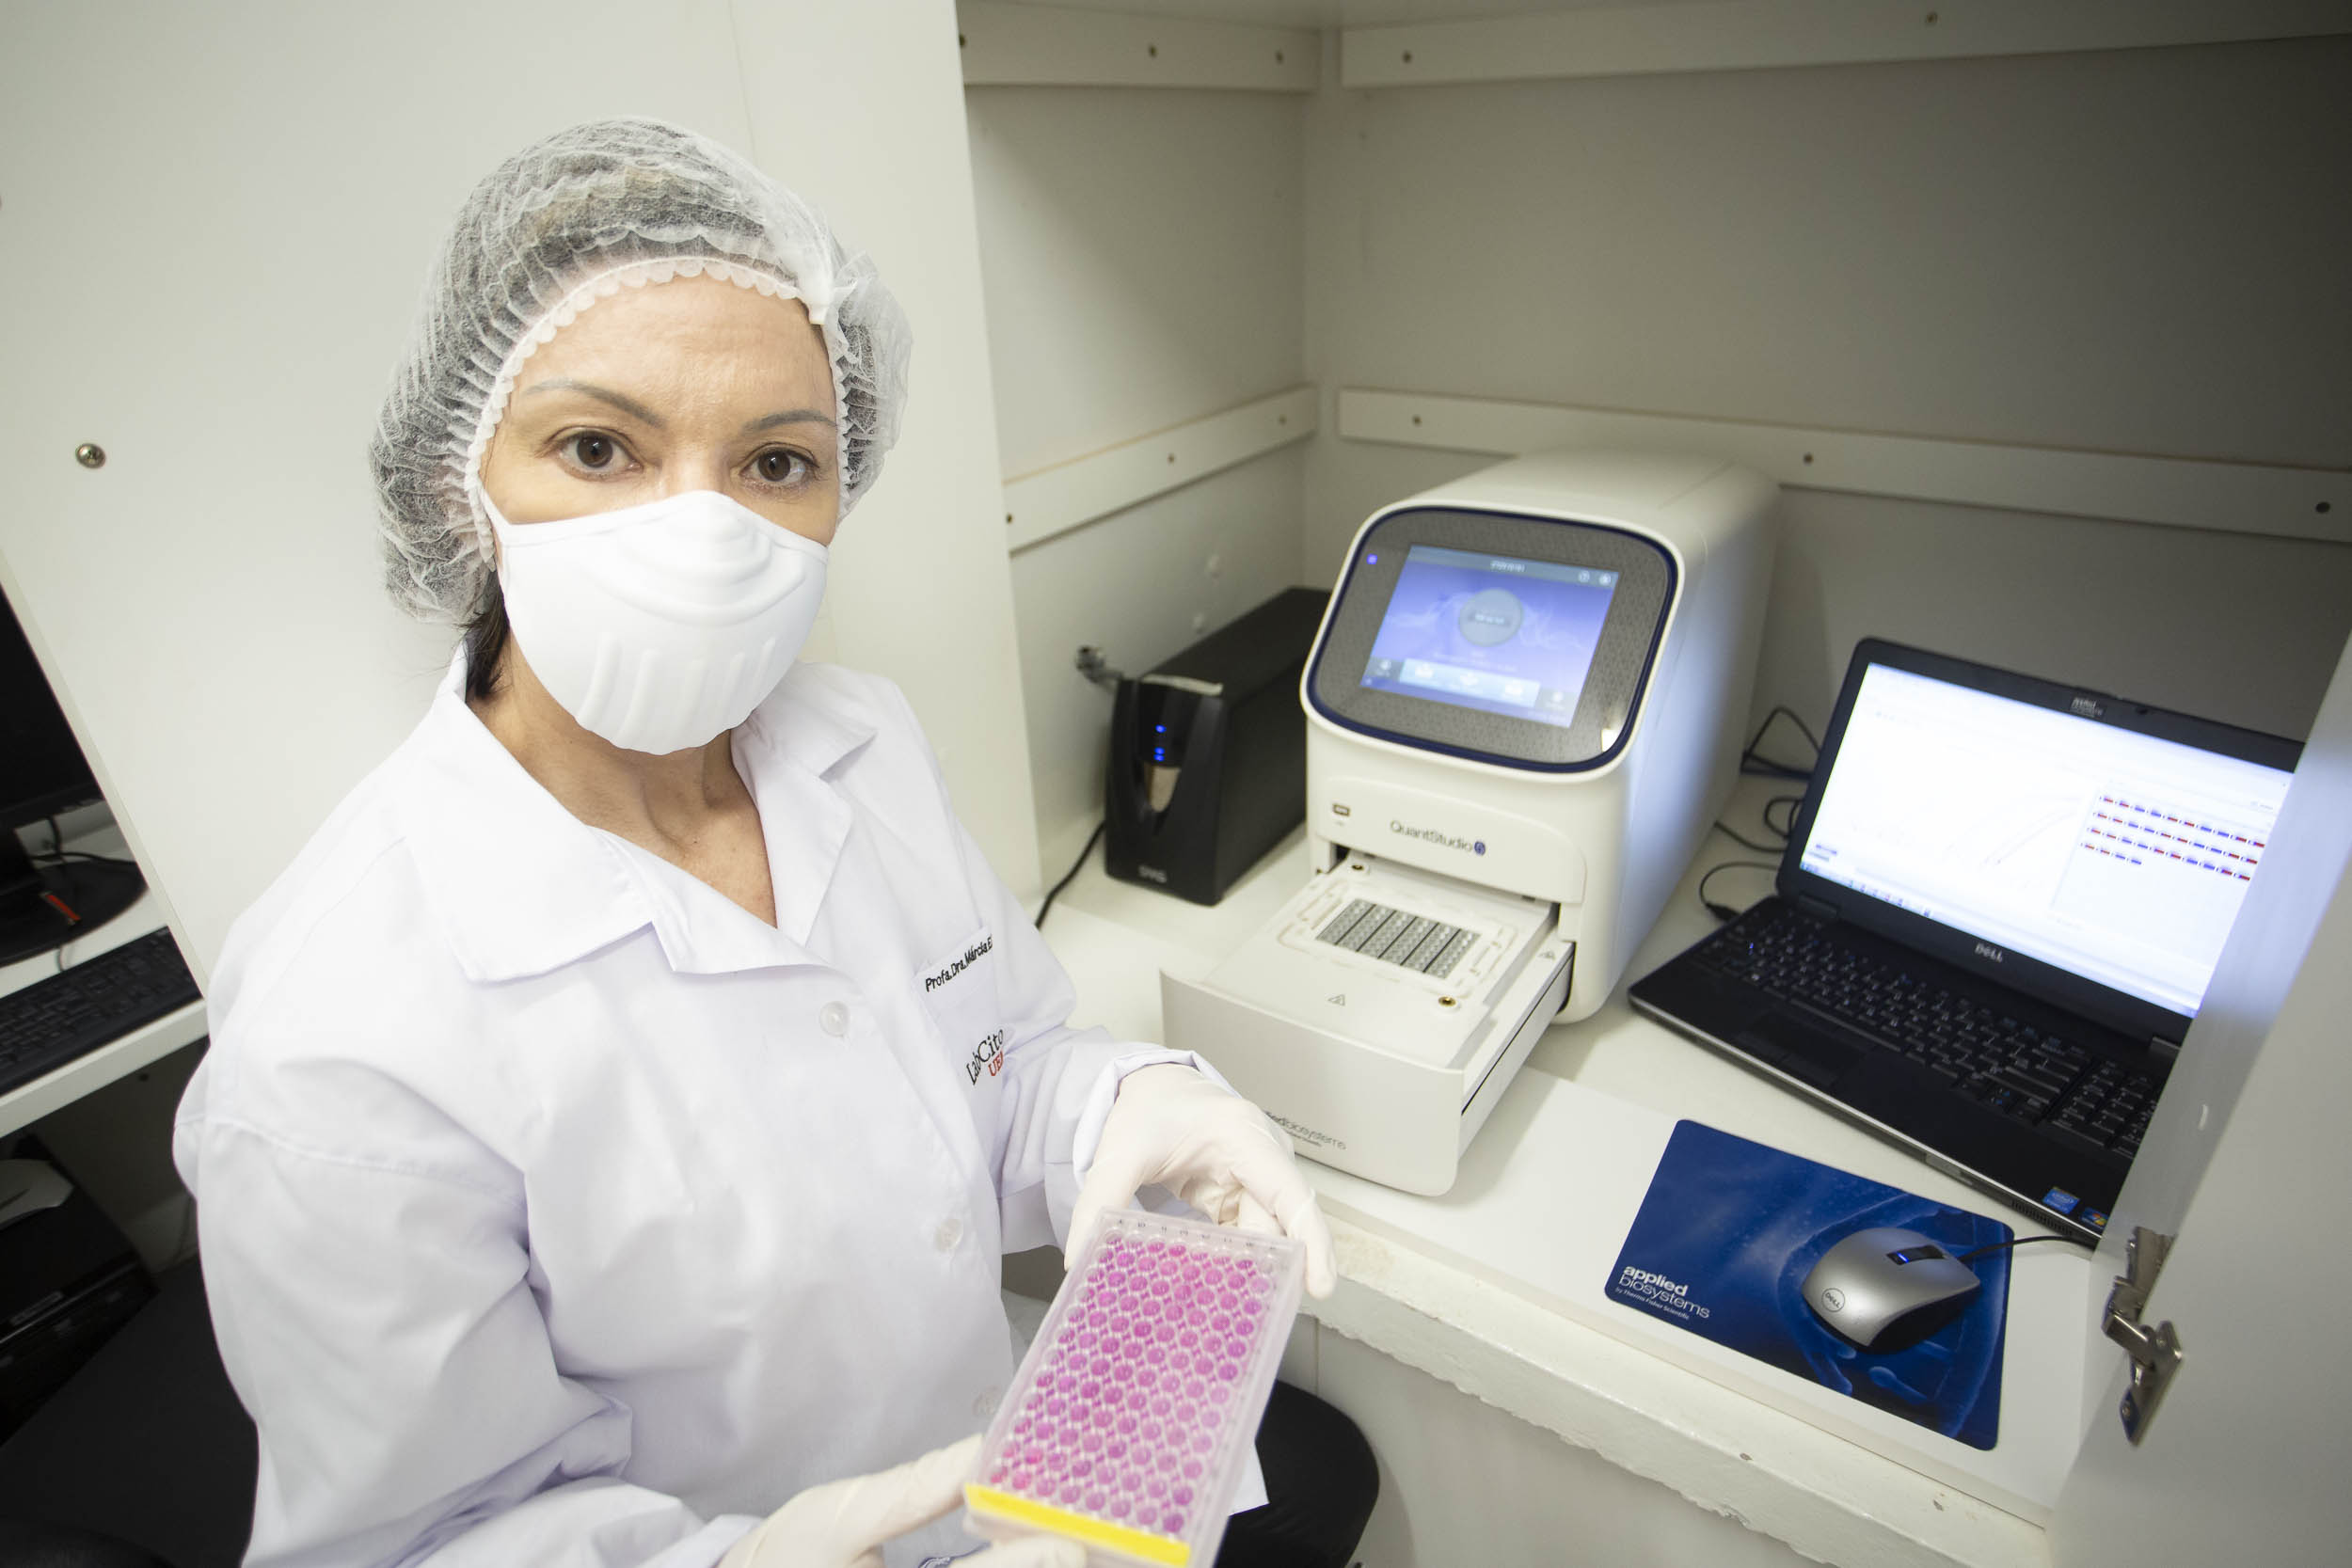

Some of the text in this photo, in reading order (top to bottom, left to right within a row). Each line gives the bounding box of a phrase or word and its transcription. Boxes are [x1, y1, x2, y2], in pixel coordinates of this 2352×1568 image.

[1391, 820, 1473, 852] QuantStudio
[1975, 942, 2003, 963] DELL
[966, 1029, 1004, 1085] LabCito
[1618, 1274, 1710, 1319] biosystems
[1623, 1265, 1689, 1297] applied
[1624, 1290, 1645, 1302] Thermo
[1645, 1297, 1663, 1308] Fisher
[1663, 1306, 1690, 1321] Scientific
[1825, 1292, 1840, 1308] DELL
